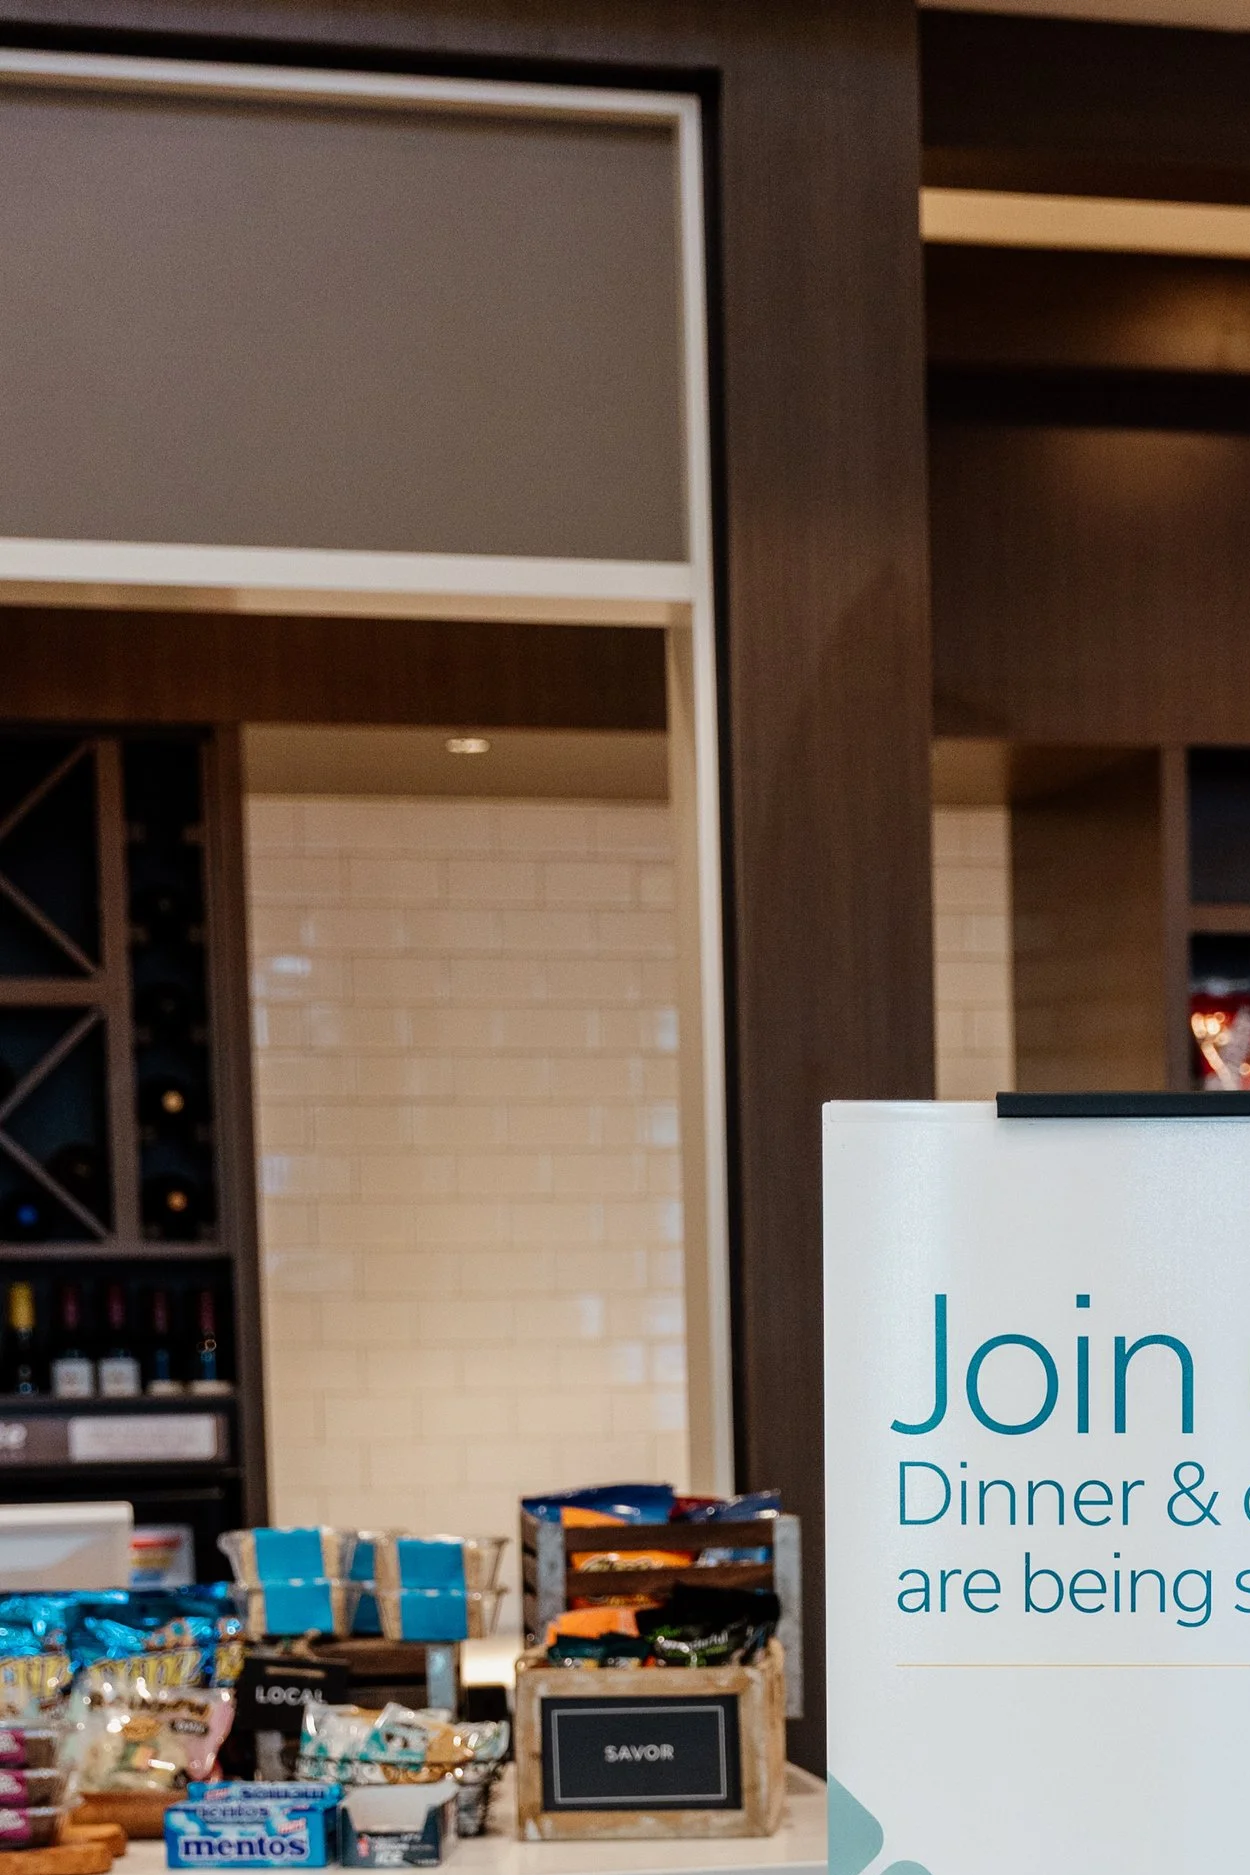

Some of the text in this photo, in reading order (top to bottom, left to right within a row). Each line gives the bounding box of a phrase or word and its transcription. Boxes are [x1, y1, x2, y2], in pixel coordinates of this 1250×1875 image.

[890, 1294, 1195, 1435] Join
[899, 1461, 1145, 1526] Dinner
[1166, 1461, 1222, 1527] &
[896, 1567, 1001, 1614] are
[1024, 1552, 1213, 1628] being
[255, 1685, 324, 1706] LOCAL
[604, 1743, 675, 1763] SAVOR
[183, 1837, 307, 1858] mentos
